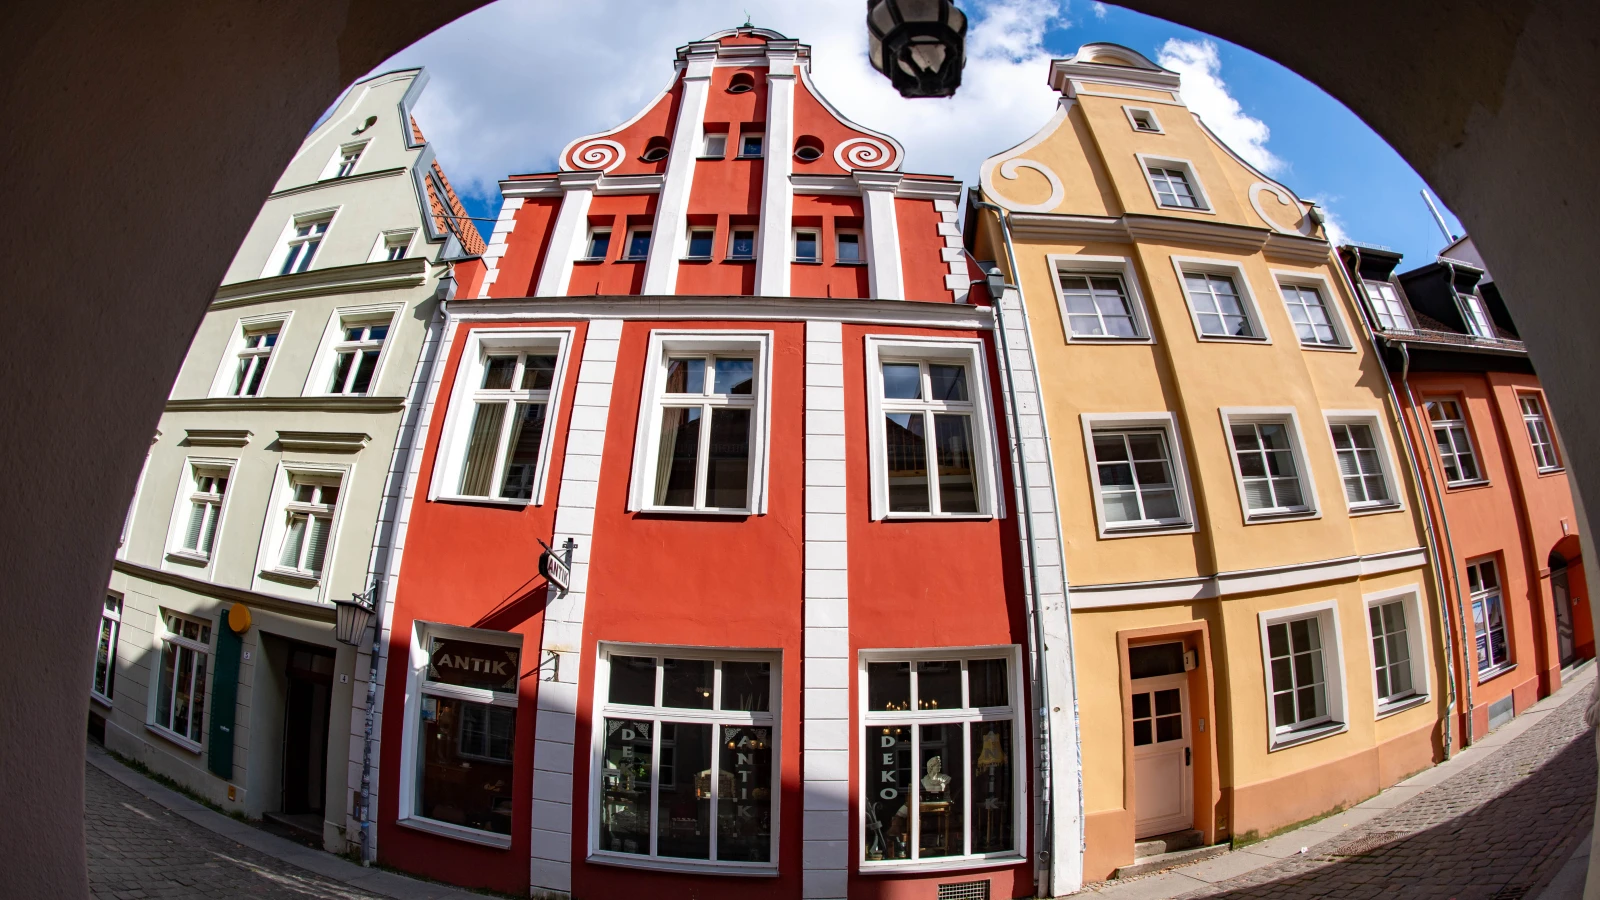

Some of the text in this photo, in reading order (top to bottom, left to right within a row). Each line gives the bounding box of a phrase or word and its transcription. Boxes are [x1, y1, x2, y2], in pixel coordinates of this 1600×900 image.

[548, 558, 568, 586] ANTIK
[437, 653, 508, 676] ANTIK
[737, 735, 753, 818] ANTIK
[880, 736, 898, 800] DEKO
